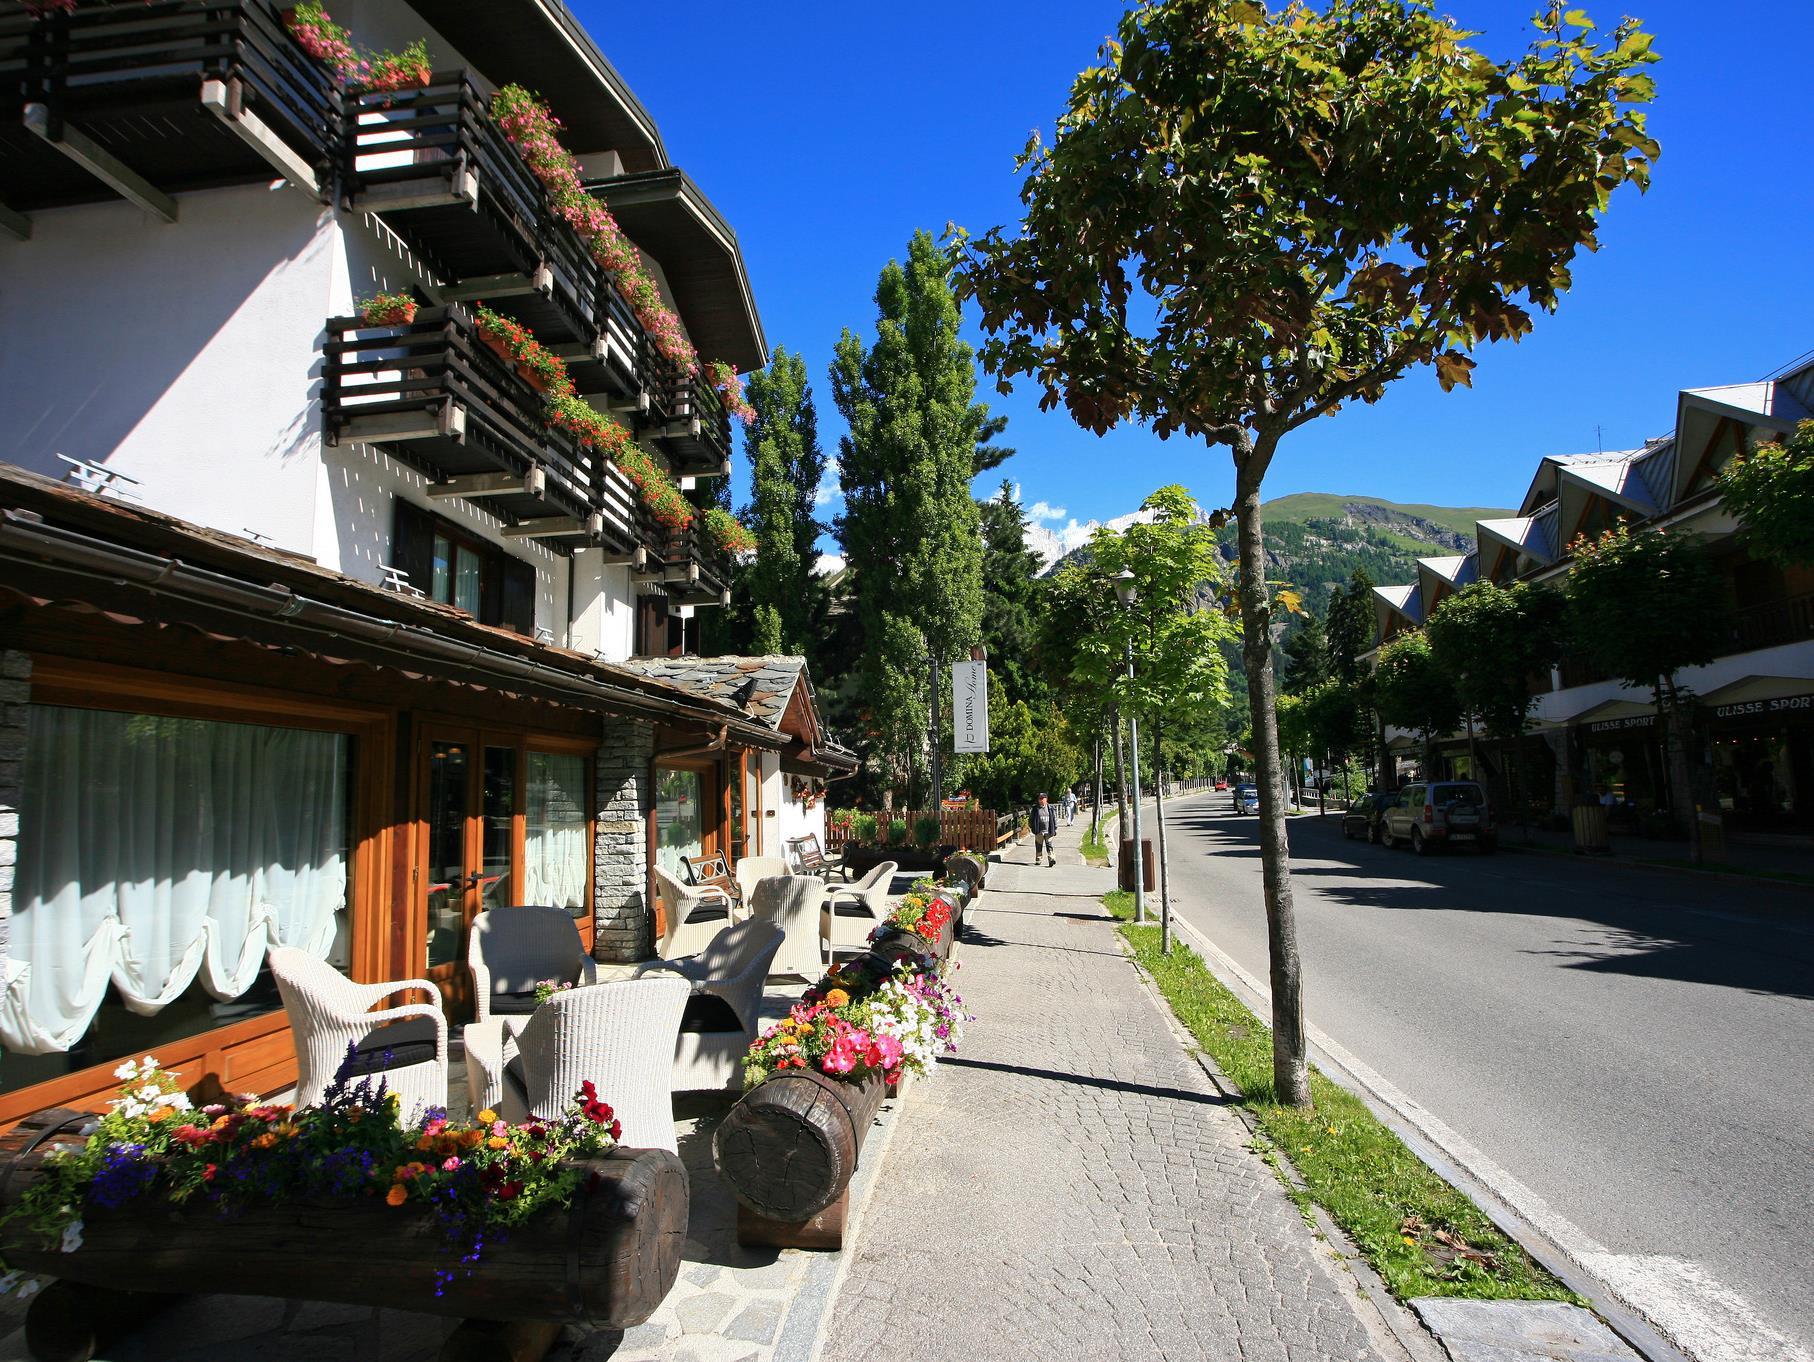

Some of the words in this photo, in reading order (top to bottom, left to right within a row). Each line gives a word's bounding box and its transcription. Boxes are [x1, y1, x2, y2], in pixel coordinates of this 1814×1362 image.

[966, 665, 977, 699] Home
[966, 696, 974, 731] DOMINA
[1716, 702, 1764, 718] ULISSE
[1591, 719, 1621, 733] ULISSE
[1624, 716, 1656, 728] SPORT
